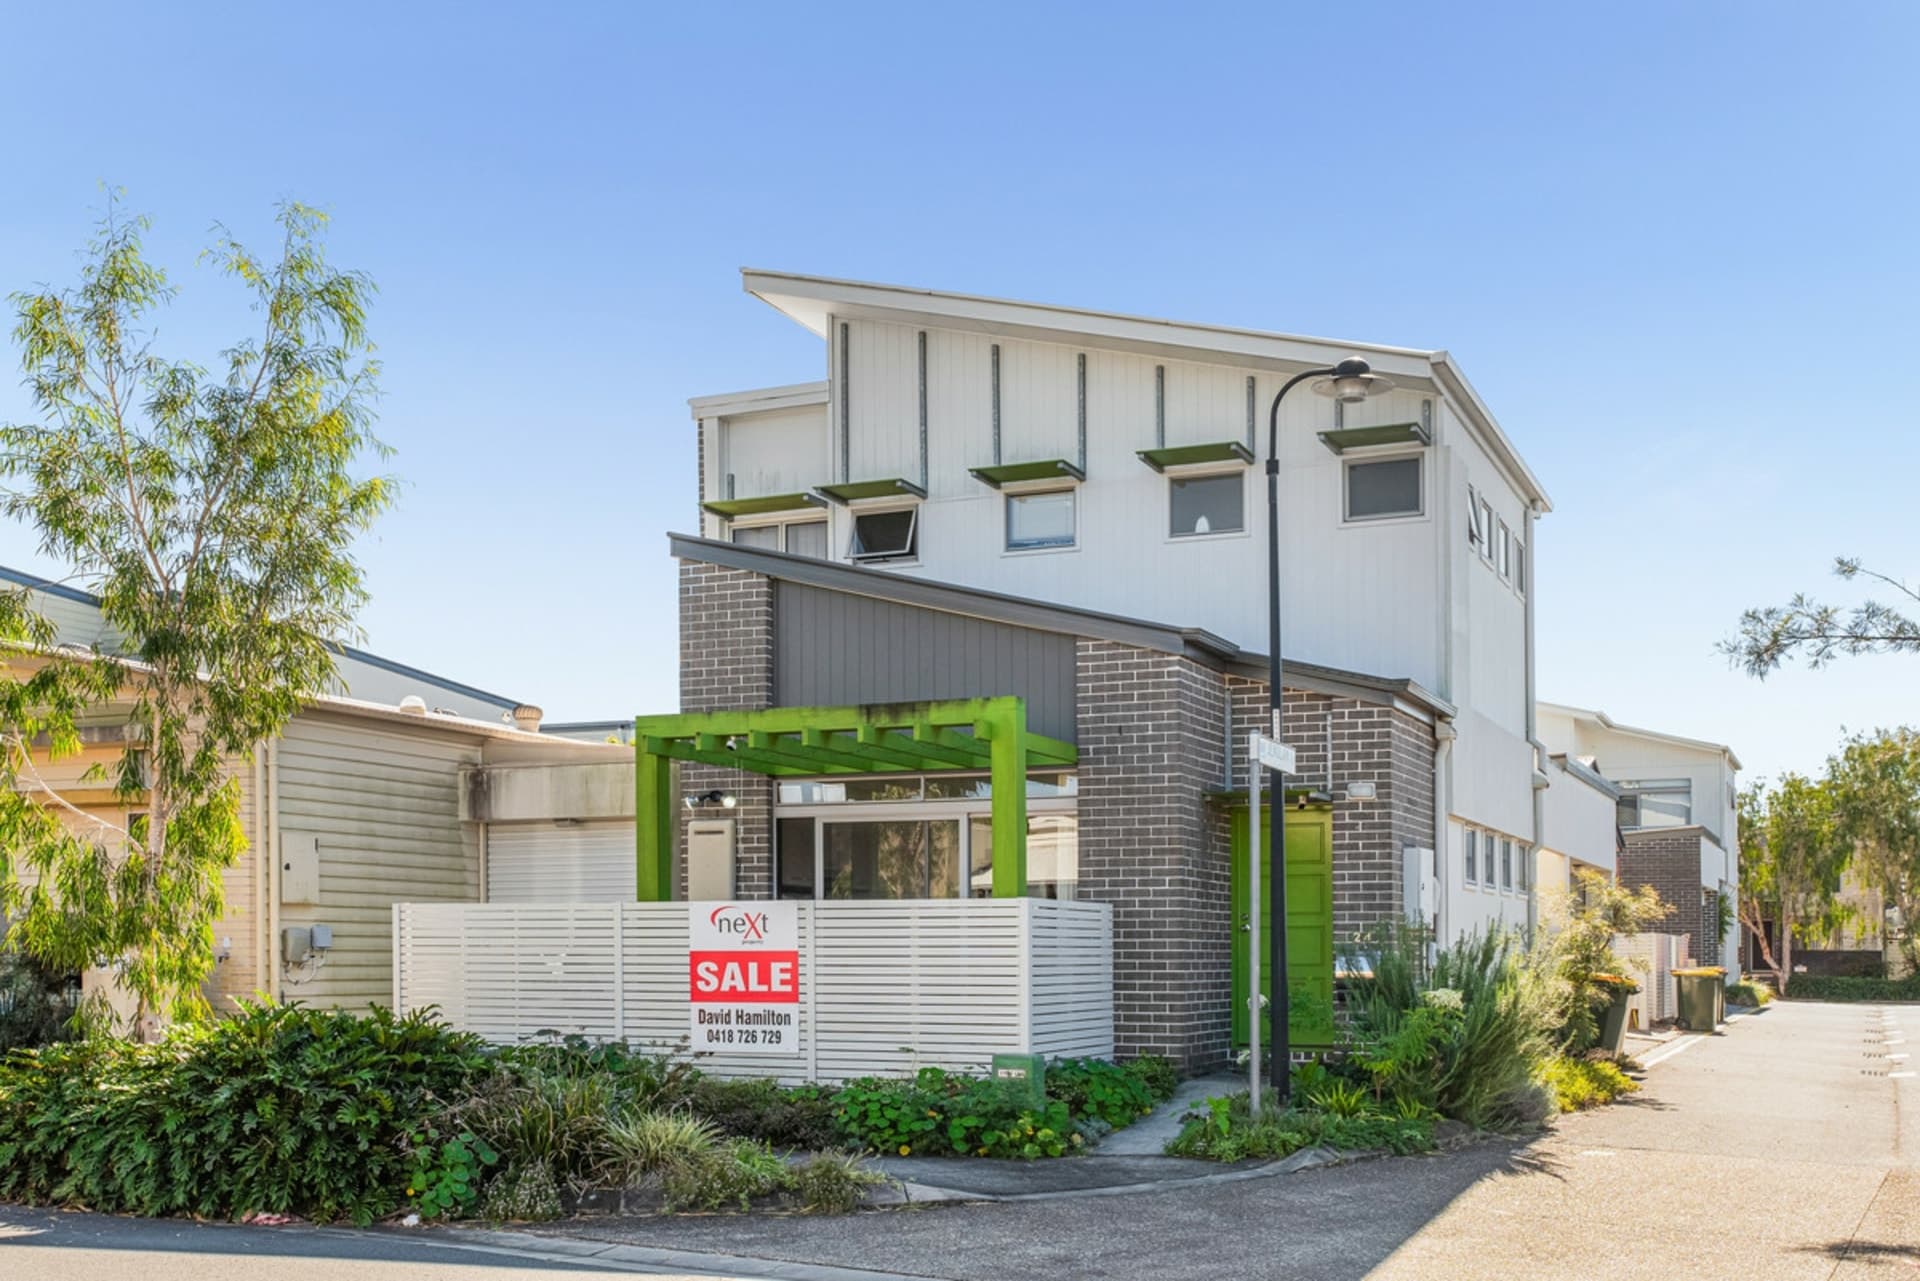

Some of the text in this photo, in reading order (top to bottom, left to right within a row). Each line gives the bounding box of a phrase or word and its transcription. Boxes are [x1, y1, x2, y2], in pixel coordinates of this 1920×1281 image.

[695, 961, 793, 993] SALE
[698, 1008, 792, 1026] David Hamilton
[706, 1029, 783, 1044] 0418 726 729
